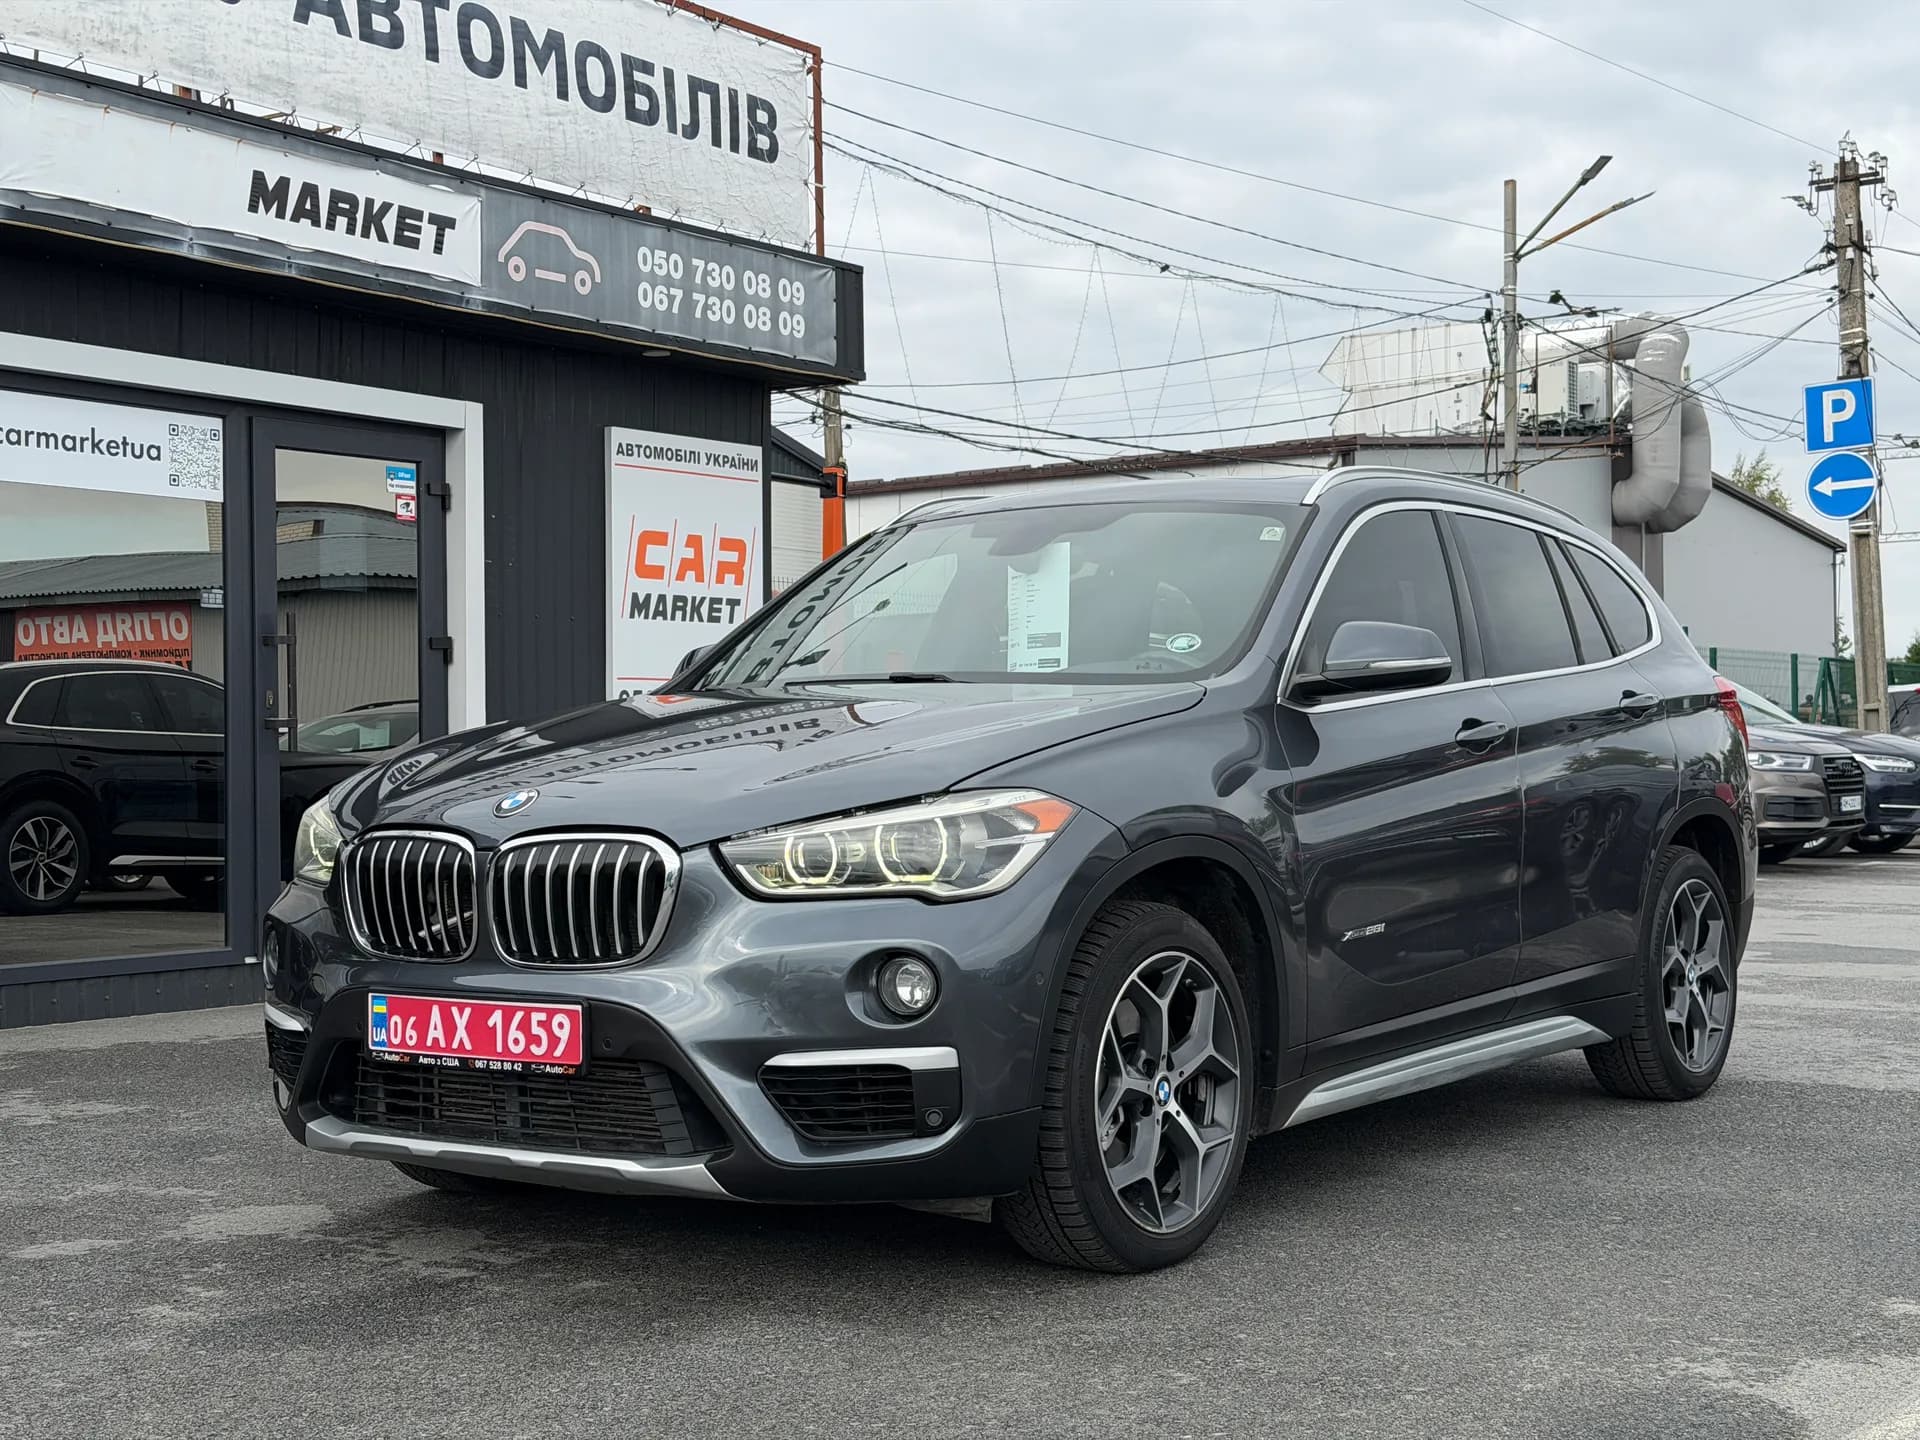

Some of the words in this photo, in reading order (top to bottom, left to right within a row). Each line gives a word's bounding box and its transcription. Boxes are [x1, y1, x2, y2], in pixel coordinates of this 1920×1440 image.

[247, 169, 457, 255] MARKET
[637, 246, 684, 280] 050
[691, 257, 736, 291] 730
[742, 270, 771, 299] 08
[778, 278, 805, 306] 09
[637, 281, 684, 314] 067
[692, 292, 736, 325] 730
[743, 303, 772, 332] 08
[778, 311, 806, 339] 09
[1822, 389, 1856, 443] P
[616, 442, 701, 465] АВТОМОБІЛІ
[704, 452, 759, 473] УКРАЇНИ
[634, 529, 747, 587] CAR
[629, 592, 741, 625] MARKET
[373, 1027, 387, 1043] UA
[390, 1015, 418, 1047] 06
[426, 1004, 473, 1051] AX
[487, 1009, 571, 1058] 1659
[442, 1057, 459, 1067] США
[474, 1060, 487, 1069] 067
[513, 1063, 522, 1072] 42
[545, 1064, 576, 1075] AutoCar
